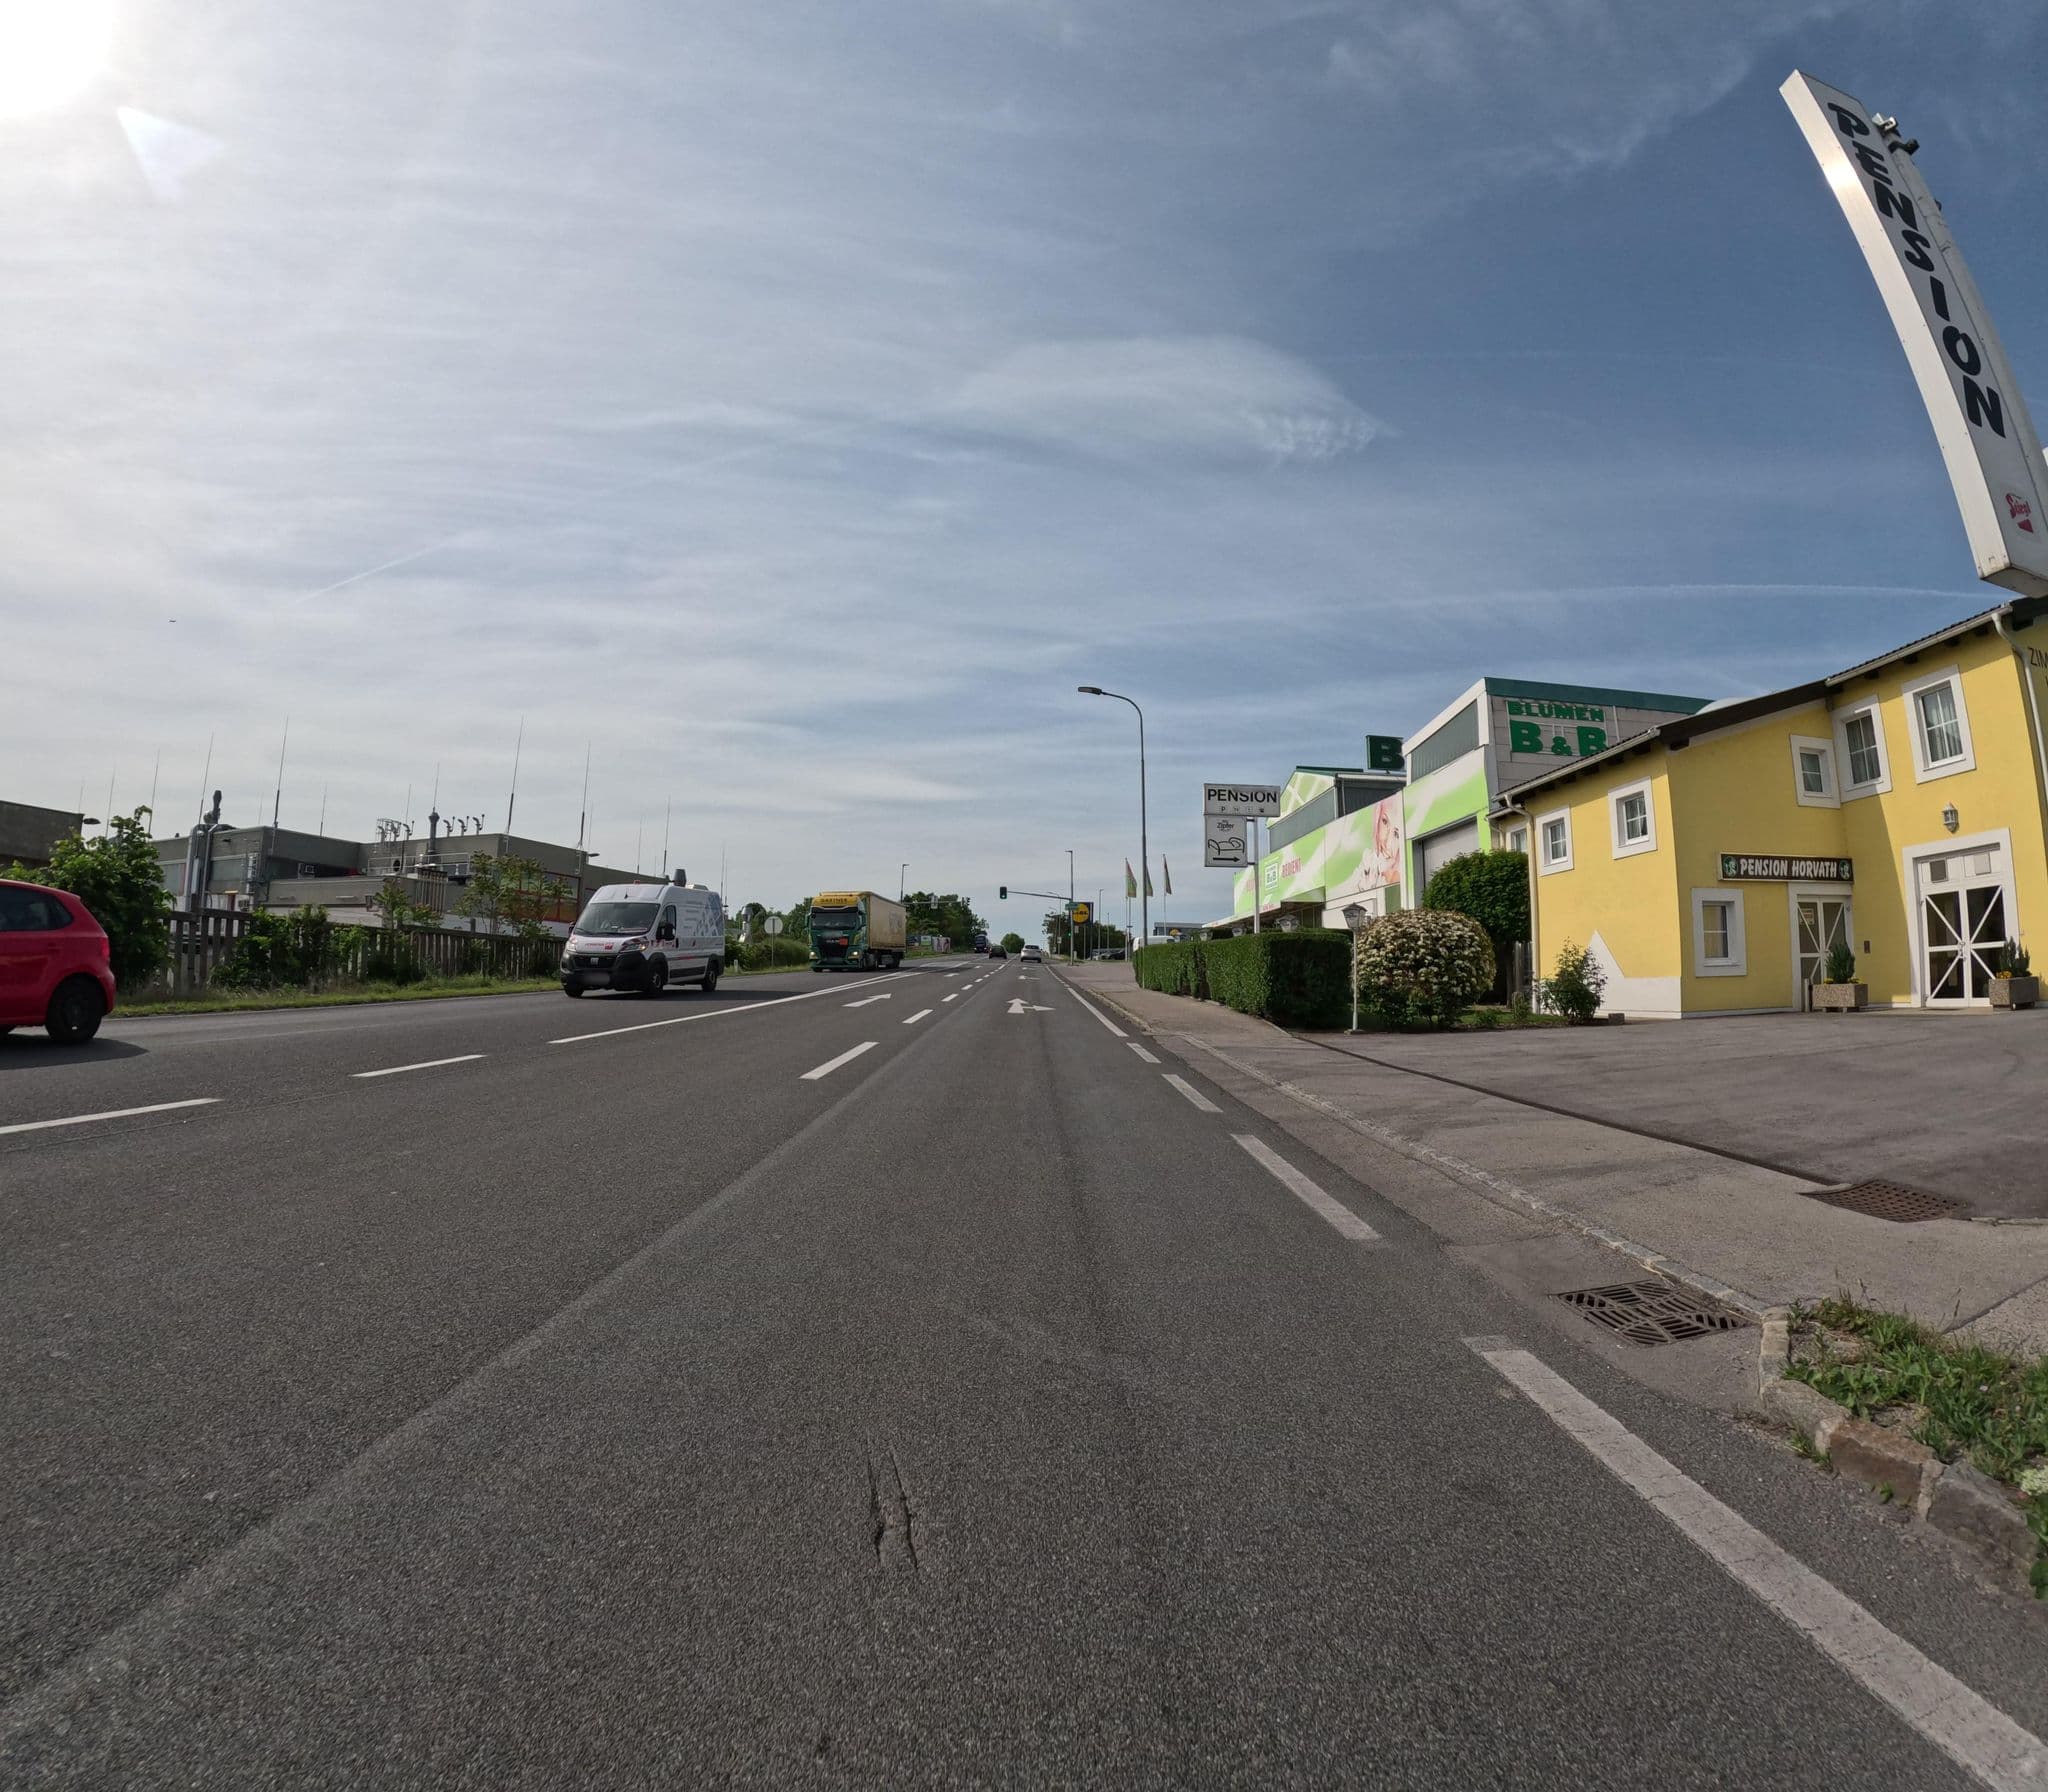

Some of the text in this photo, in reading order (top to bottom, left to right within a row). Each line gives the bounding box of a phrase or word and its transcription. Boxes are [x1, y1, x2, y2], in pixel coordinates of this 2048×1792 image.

[1828, 102, 2006, 439] PENSION
[1508, 701, 1604, 722] BLUMEN
[1207, 788, 1277, 803] PENSION
[1740, 858, 1837, 878] PENSION HORVATH
